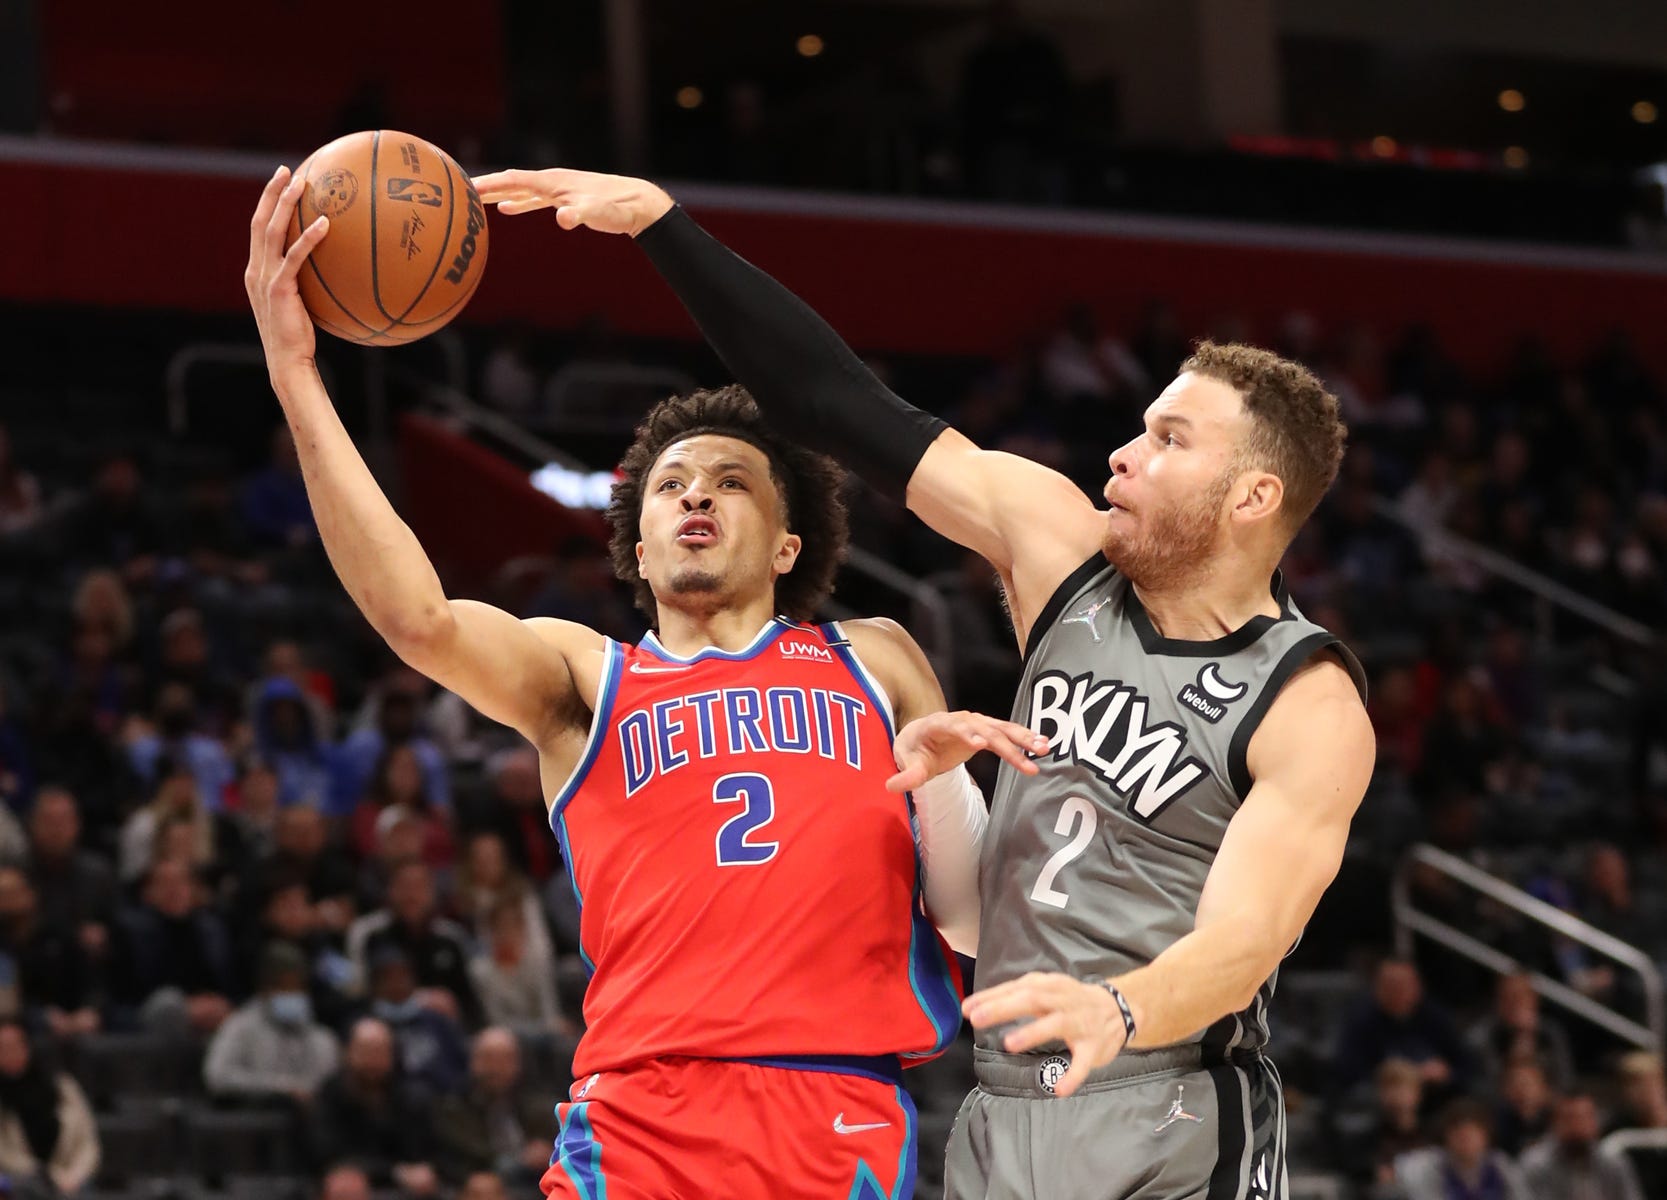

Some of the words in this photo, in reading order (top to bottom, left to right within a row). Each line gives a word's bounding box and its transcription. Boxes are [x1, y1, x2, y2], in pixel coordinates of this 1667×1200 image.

[779, 641, 833, 660] UWM
[617, 686, 867, 799] DETROIT
[1026, 671, 1208, 822] BKLYN
[712, 771, 780, 867] 2
[1030, 796, 1098, 909] 2
